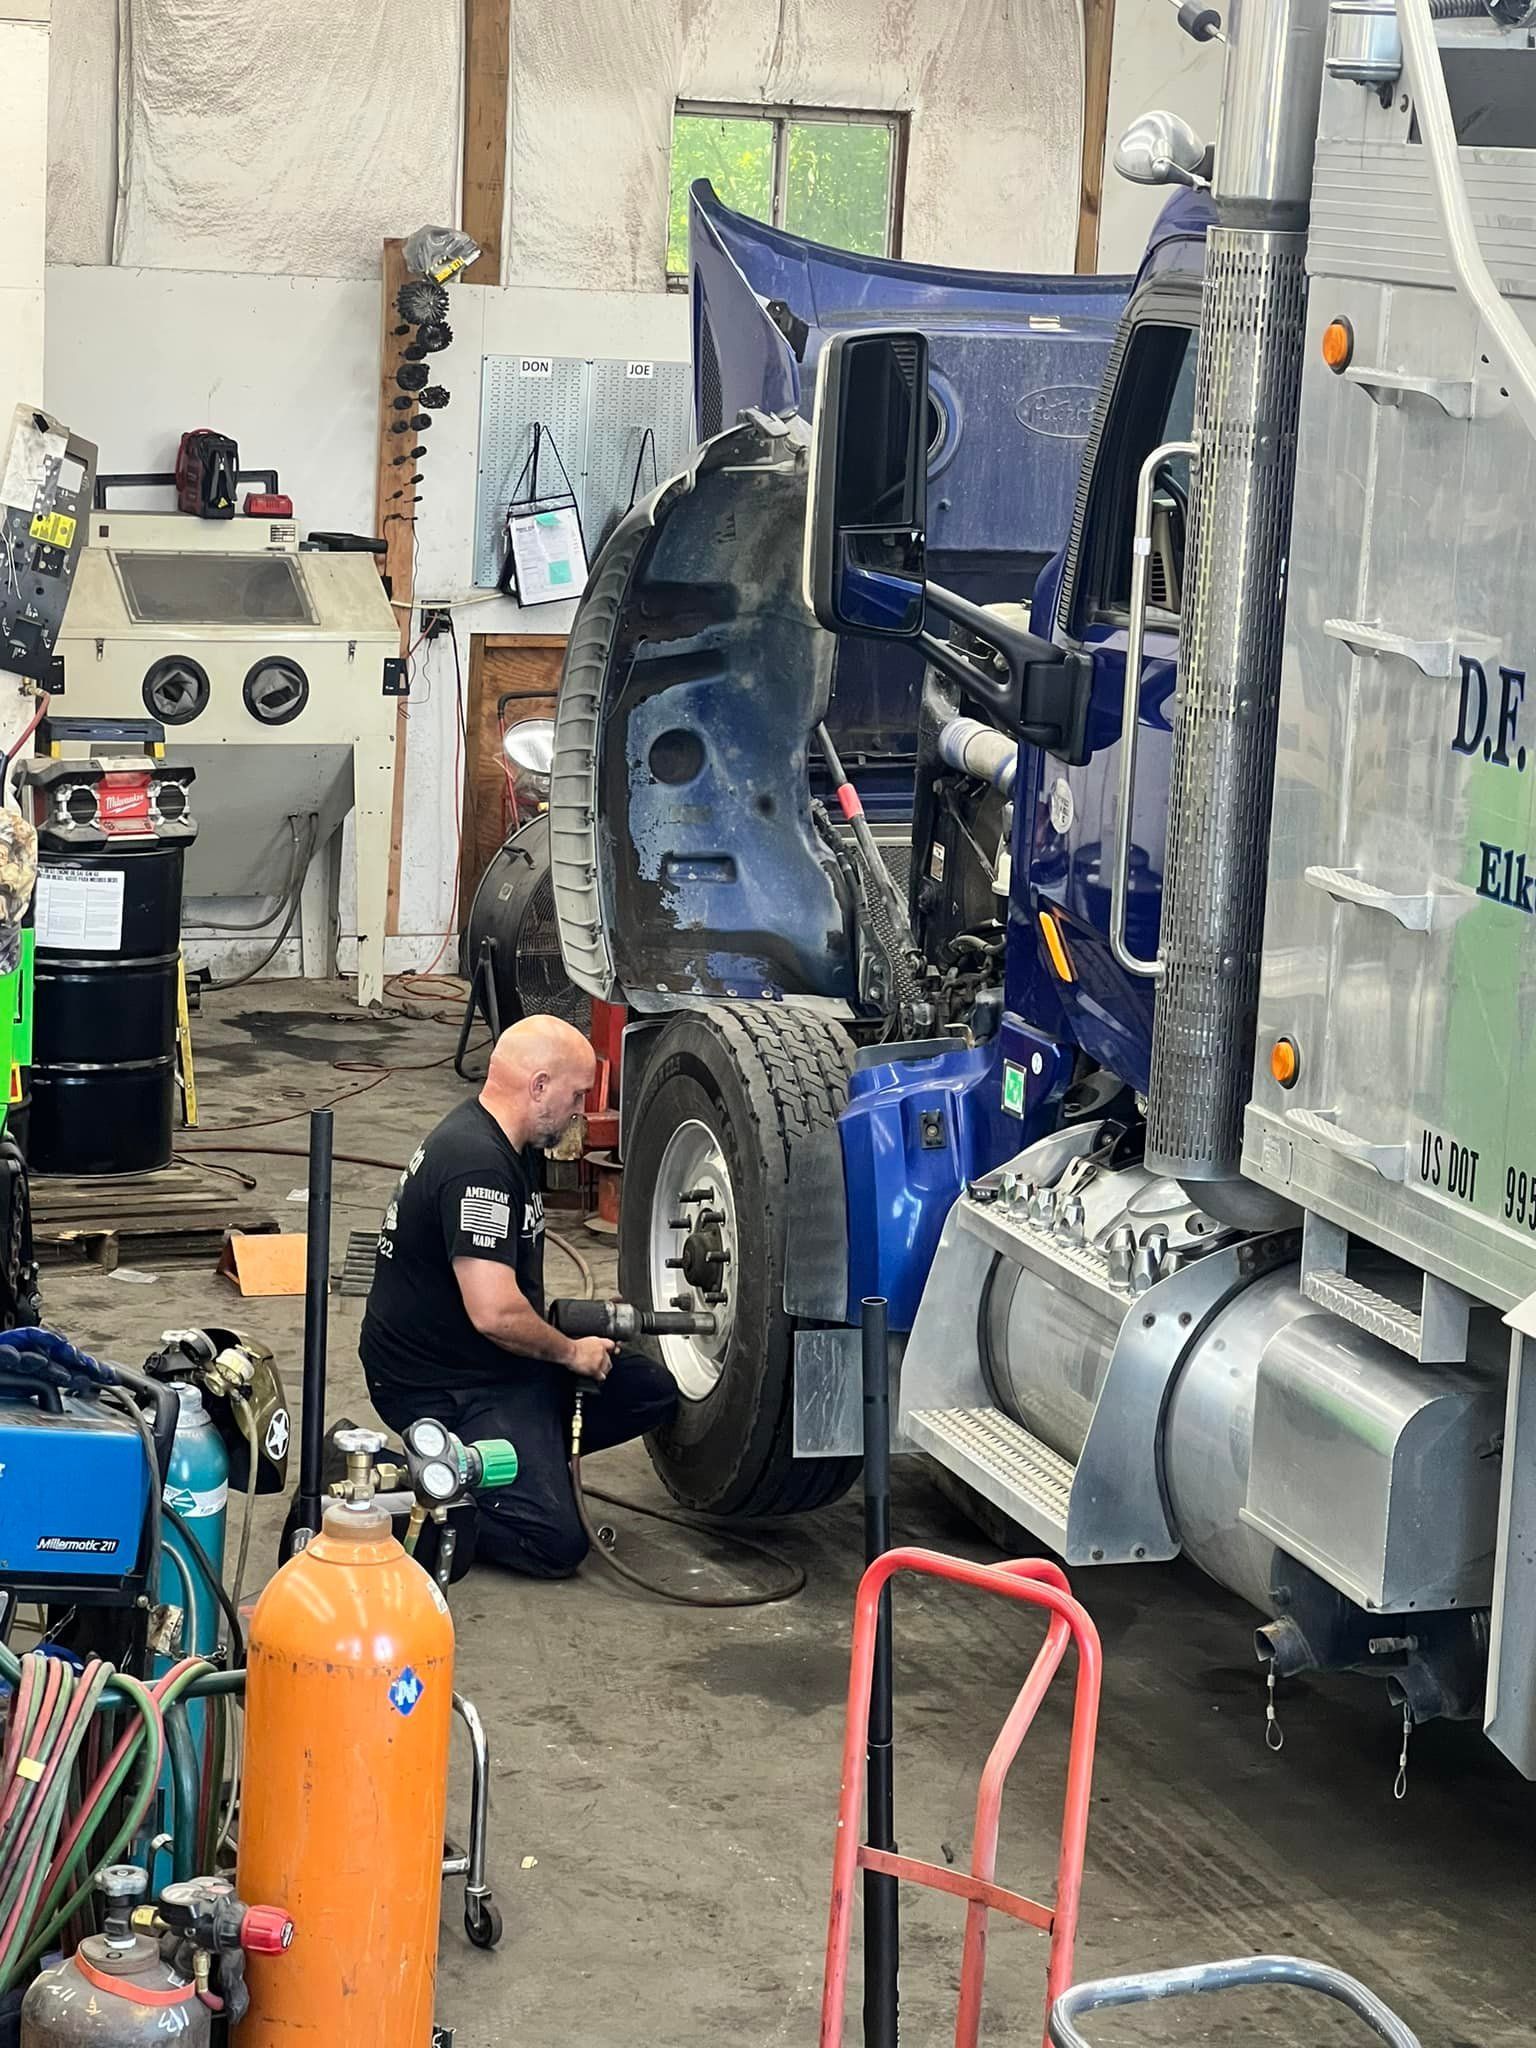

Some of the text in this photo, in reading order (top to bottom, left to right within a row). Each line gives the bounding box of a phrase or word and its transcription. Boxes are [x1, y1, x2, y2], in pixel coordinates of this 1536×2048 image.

[522, 361, 549, 372] DON
[630, 365, 651, 375] JOE
[1452, 654, 1527, 772] D.F.
[1476, 840, 1536, 914] Elk
[1421, 1129, 1443, 1186] US
[1448, 1141, 1480, 1202] DOT
[465, 1186, 510, 1204] AMERICAN
[472, 1233, 497, 1249] MADE
[36, 1538, 117, 1552] Millermatic 211
